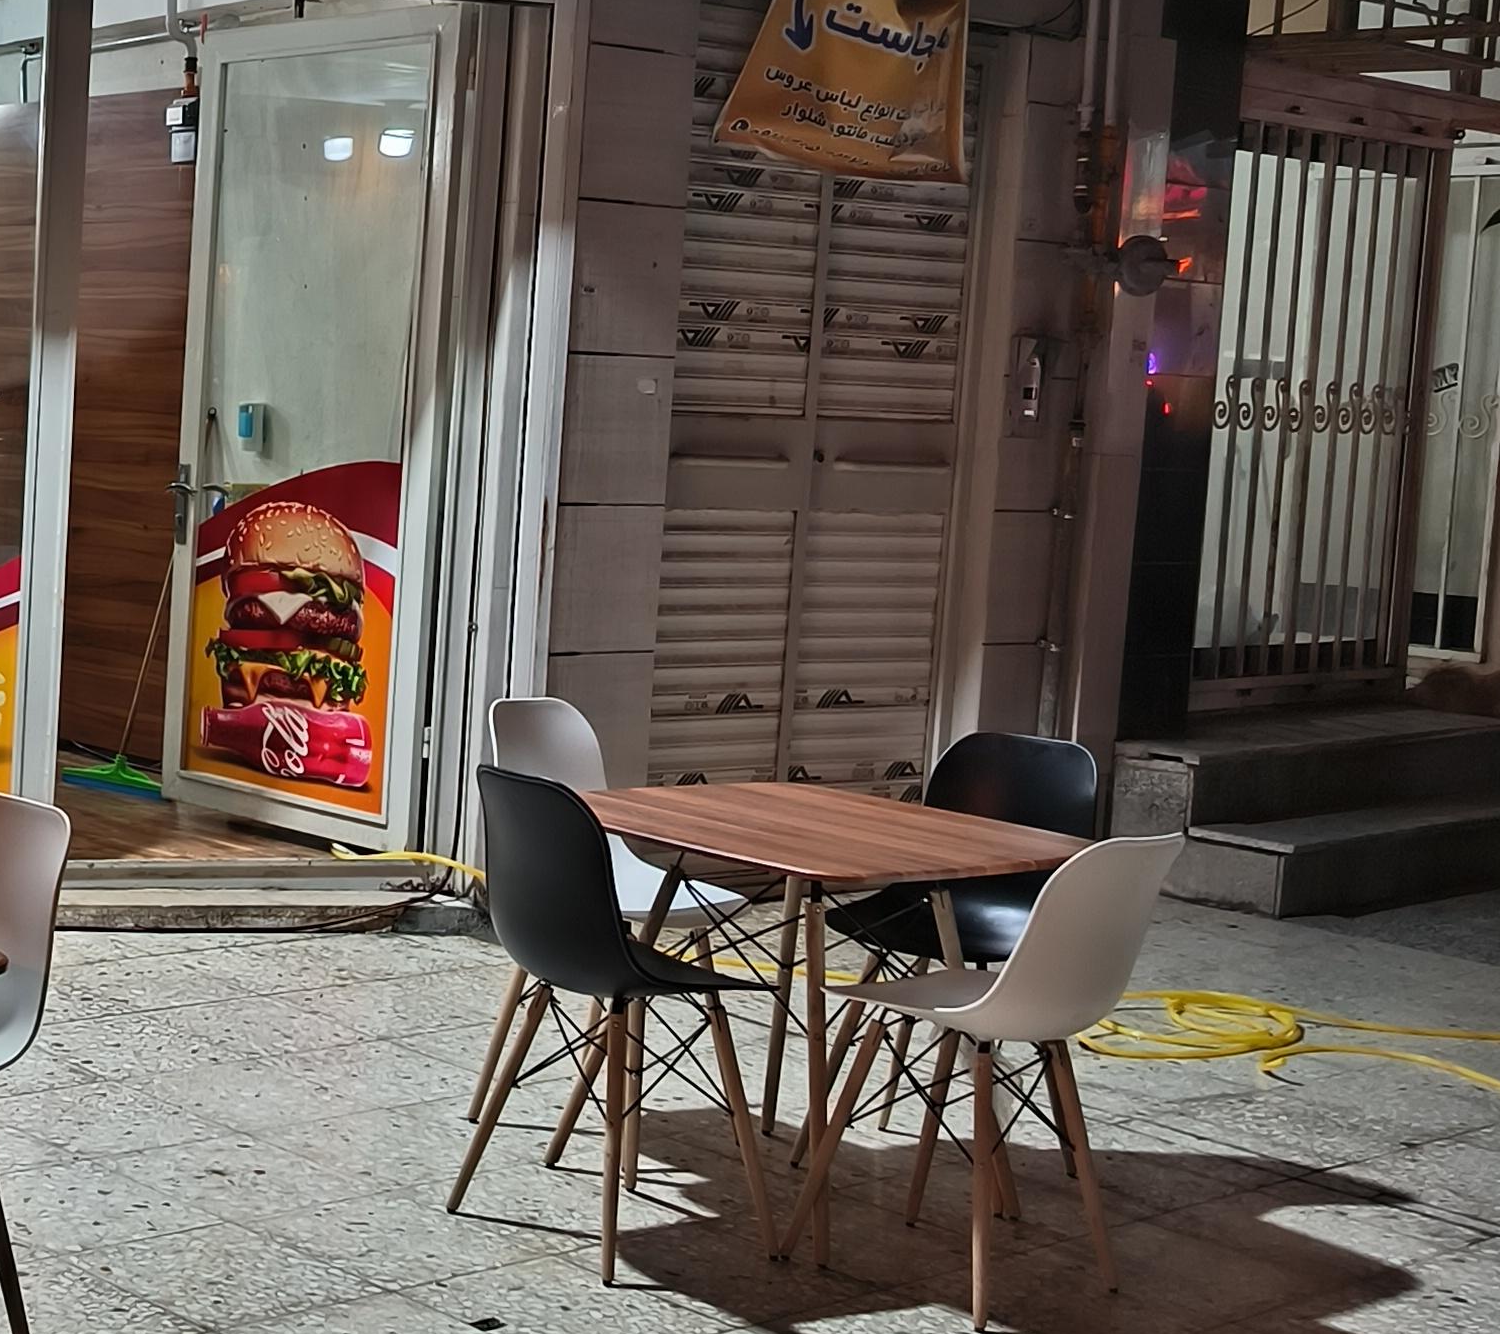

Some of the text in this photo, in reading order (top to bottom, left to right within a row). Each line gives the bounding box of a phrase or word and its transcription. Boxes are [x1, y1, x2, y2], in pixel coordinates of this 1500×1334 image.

[765, 66, 813, 93] عروس
[816, 90, 862, 109] لباس
[781, 101, 827, 127] شلوار
